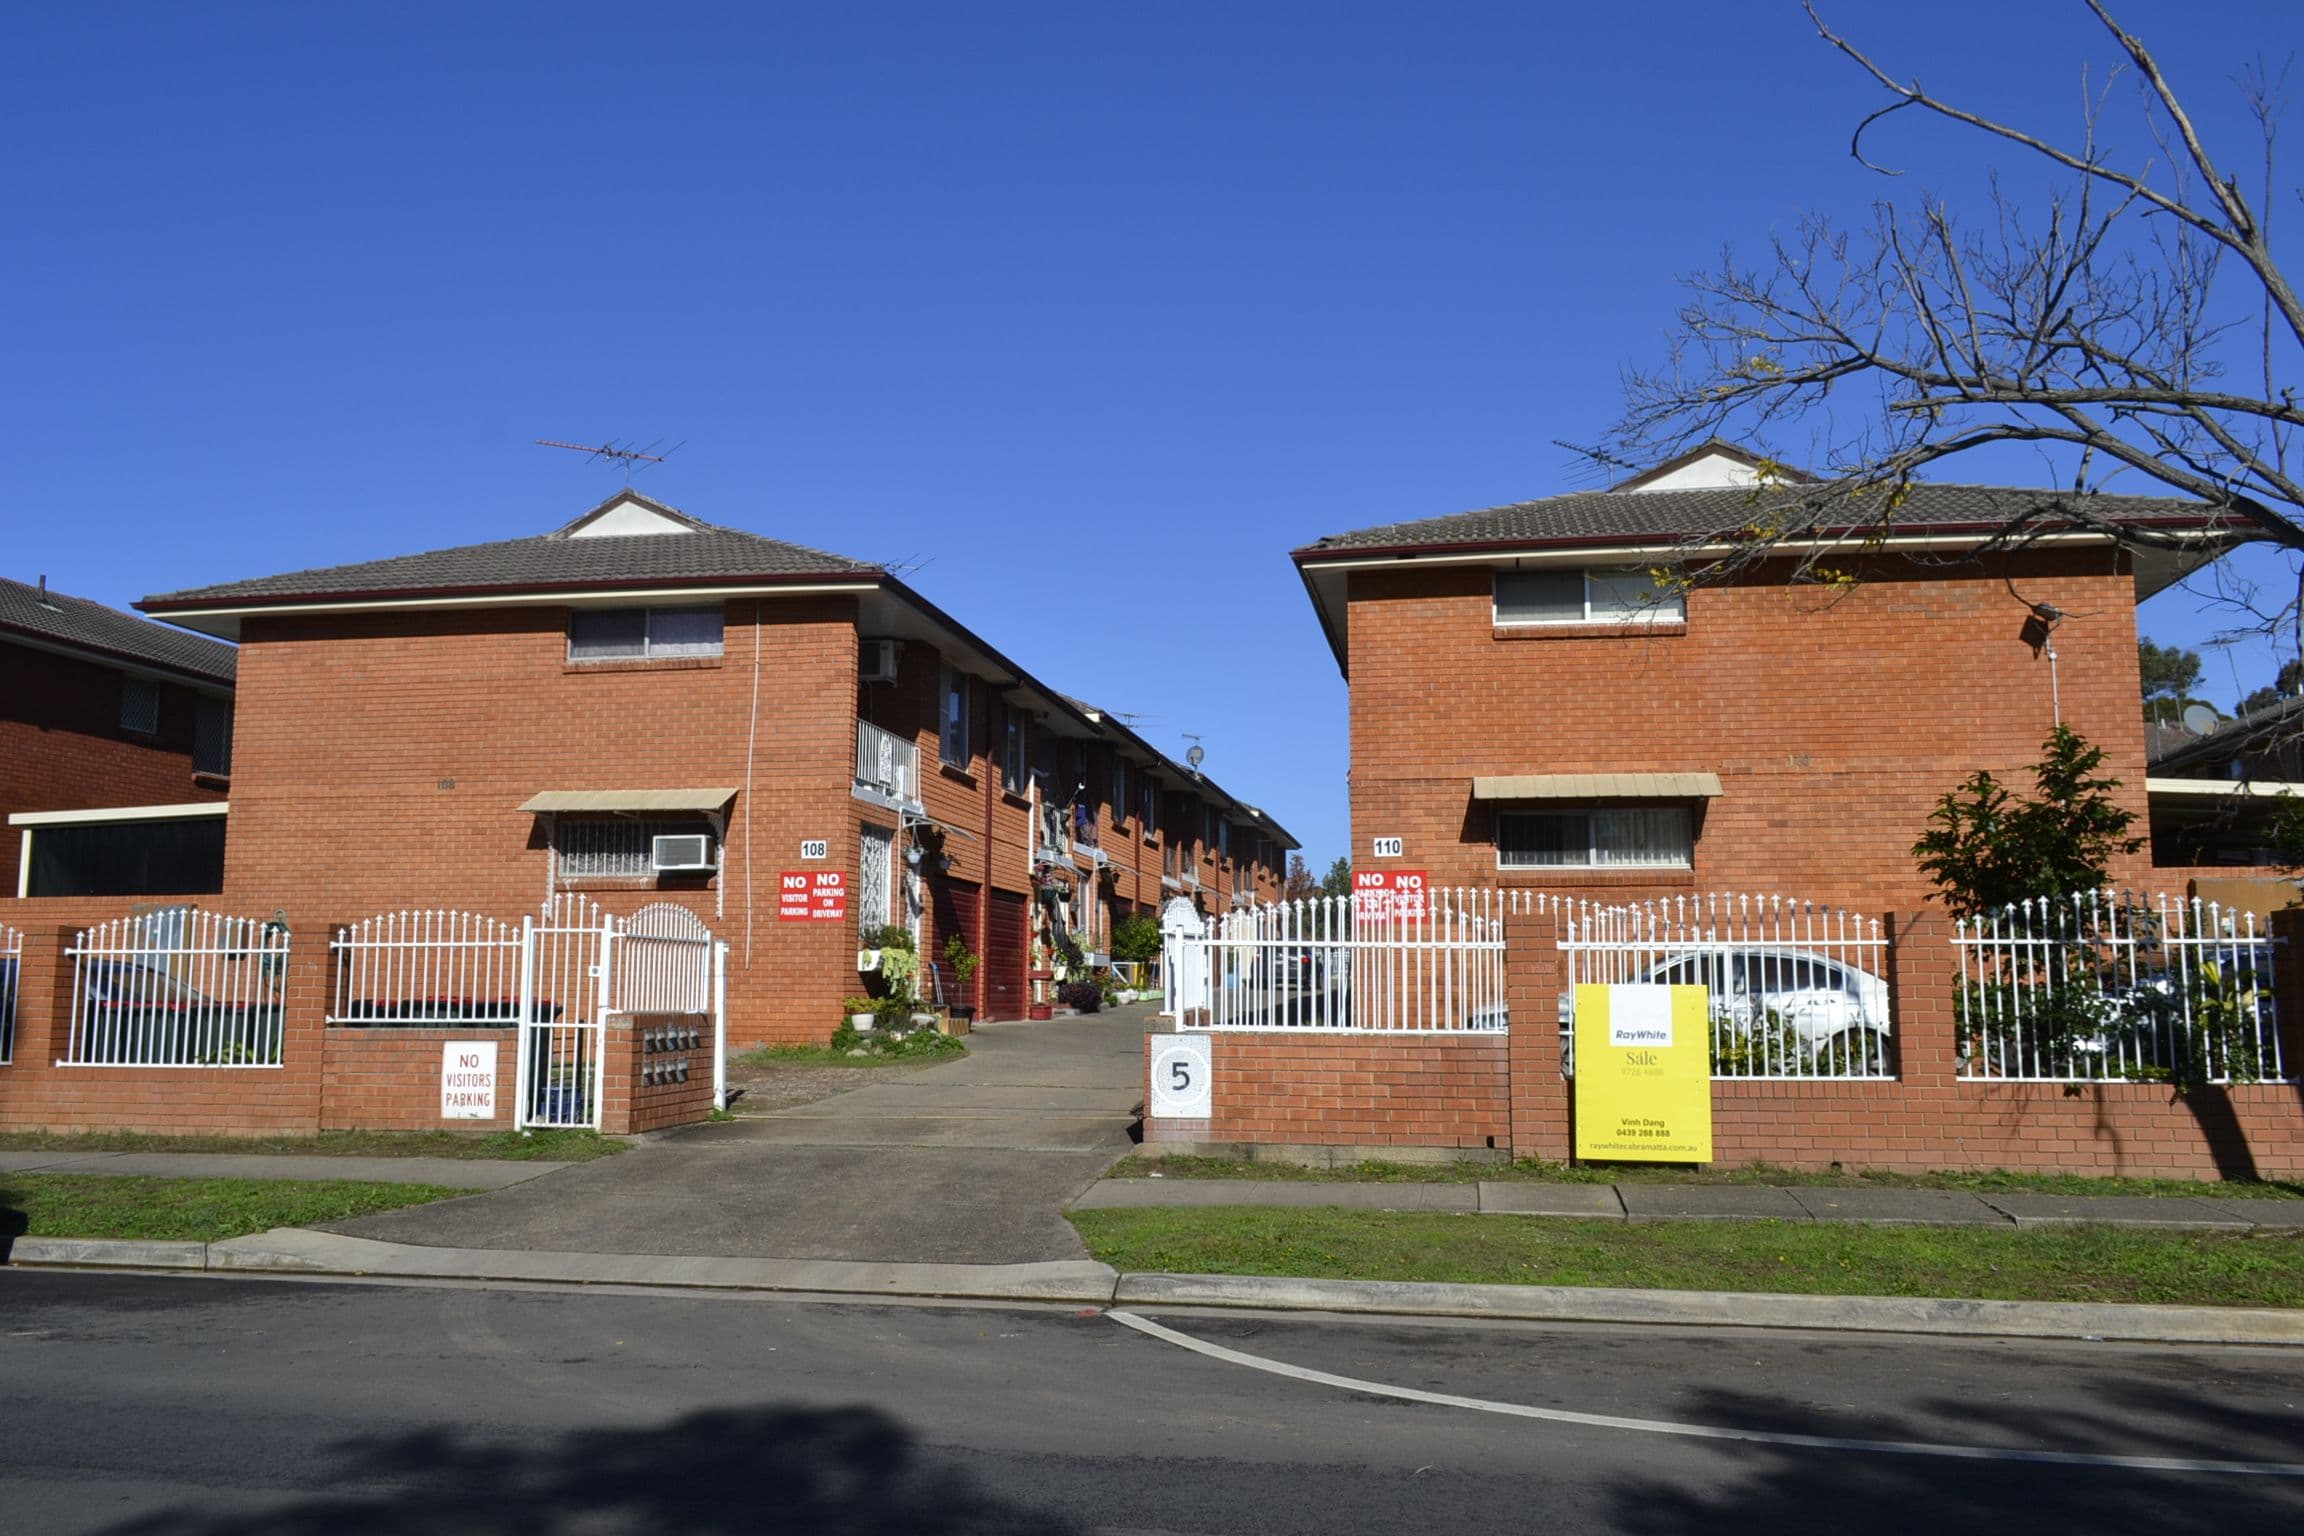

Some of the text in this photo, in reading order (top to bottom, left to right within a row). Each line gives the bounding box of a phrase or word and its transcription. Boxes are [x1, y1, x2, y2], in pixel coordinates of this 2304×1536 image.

[803, 842, 825, 856] 108
[1375, 839, 1400, 854] 110
[783, 876, 807, 889] NO
[816, 873, 840, 886] NO
[1358, 873, 1384, 887] NO
[1395, 875, 1422, 889] NO
[781, 893, 808, 903] VISITOR
[812, 887, 845, 897] PARKING
[822, 898, 834, 907] ON
[812, 909, 844, 919] DRIVEWAY
[1615, 1029, 1668, 1041] RayWhite
[459, 1054, 480, 1069] NO
[1625, 1050, 1658, 1067] Sale
[446, 1073, 492, 1088] VISITORS
[1172, 1062, 1190, 1091] 5
[445, 1092, 491, 1108] PARKING
[1621, 1118, 1665, 1129] Vinh Dang
[1616, 1128, 1637, 1137] 0439
[1589, 1141, 1699, 1153] raywhitecabramatta.com.au
